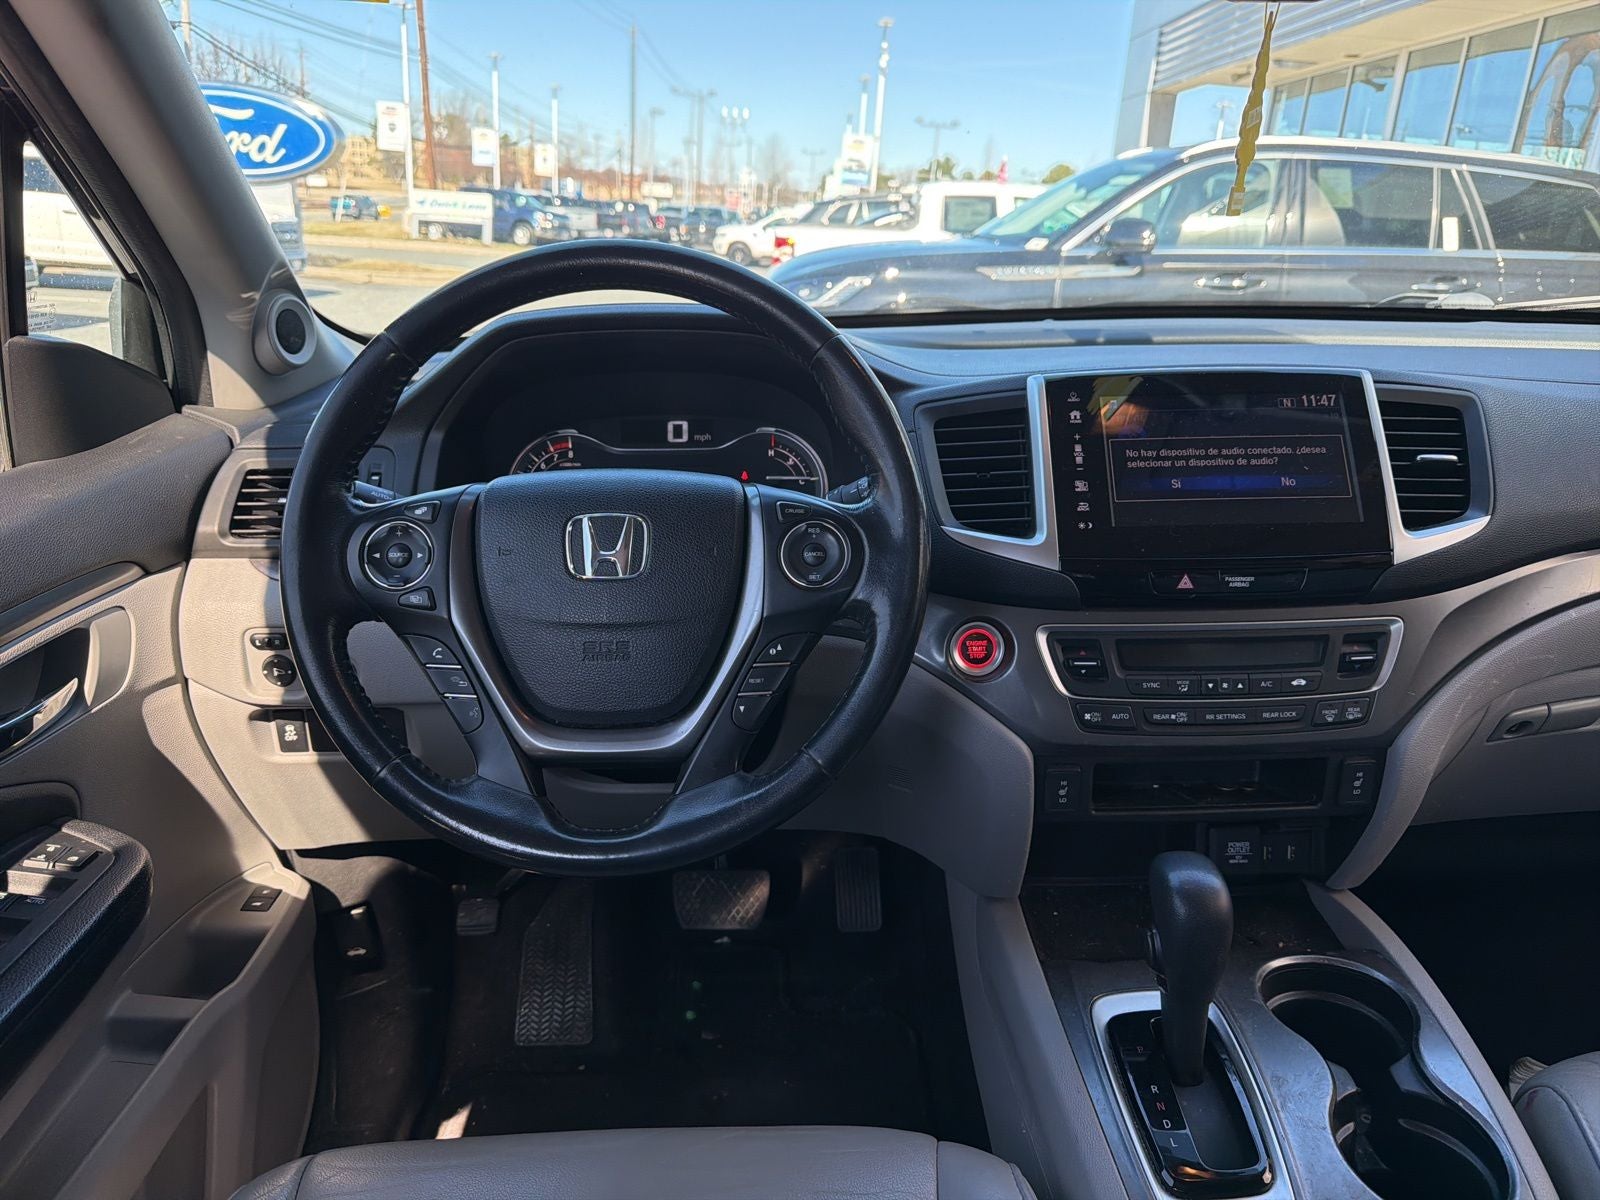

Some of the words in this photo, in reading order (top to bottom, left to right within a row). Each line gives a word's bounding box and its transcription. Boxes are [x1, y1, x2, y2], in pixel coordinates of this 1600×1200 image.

[207, 103, 287, 164] rd
[1301, 394, 1336, 407] 11:47
[667, 420, 689, 443] 0
[694, 433, 712, 442] mph
[568, 450, 573, 458] 8
[1126, 449, 1139, 457] No
[1140, 449, 1157, 458] hay
[1159, 447, 1206, 457] dispositivo
[1207, 447, 1218, 455] de
[1220, 447, 1245, 455] audio
[1296, 446, 1326, 454] ¿desea
[1127, 458, 1172, 468] selecionar
[1174, 459, 1186, 467] un
[1188, 458, 1235, 467] dispositivo
[1236, 457, 1248, 465] de
[1249, 457, 1278, 465] audio?
[1281, 477, 1296, 486] No
[1151, 1085, 1159, 1093] R
[1156, 1102, 1166, 1111] N
[1163, 1120, 1171, 1128] D
[1170, 1138, 1178, 1147] L
